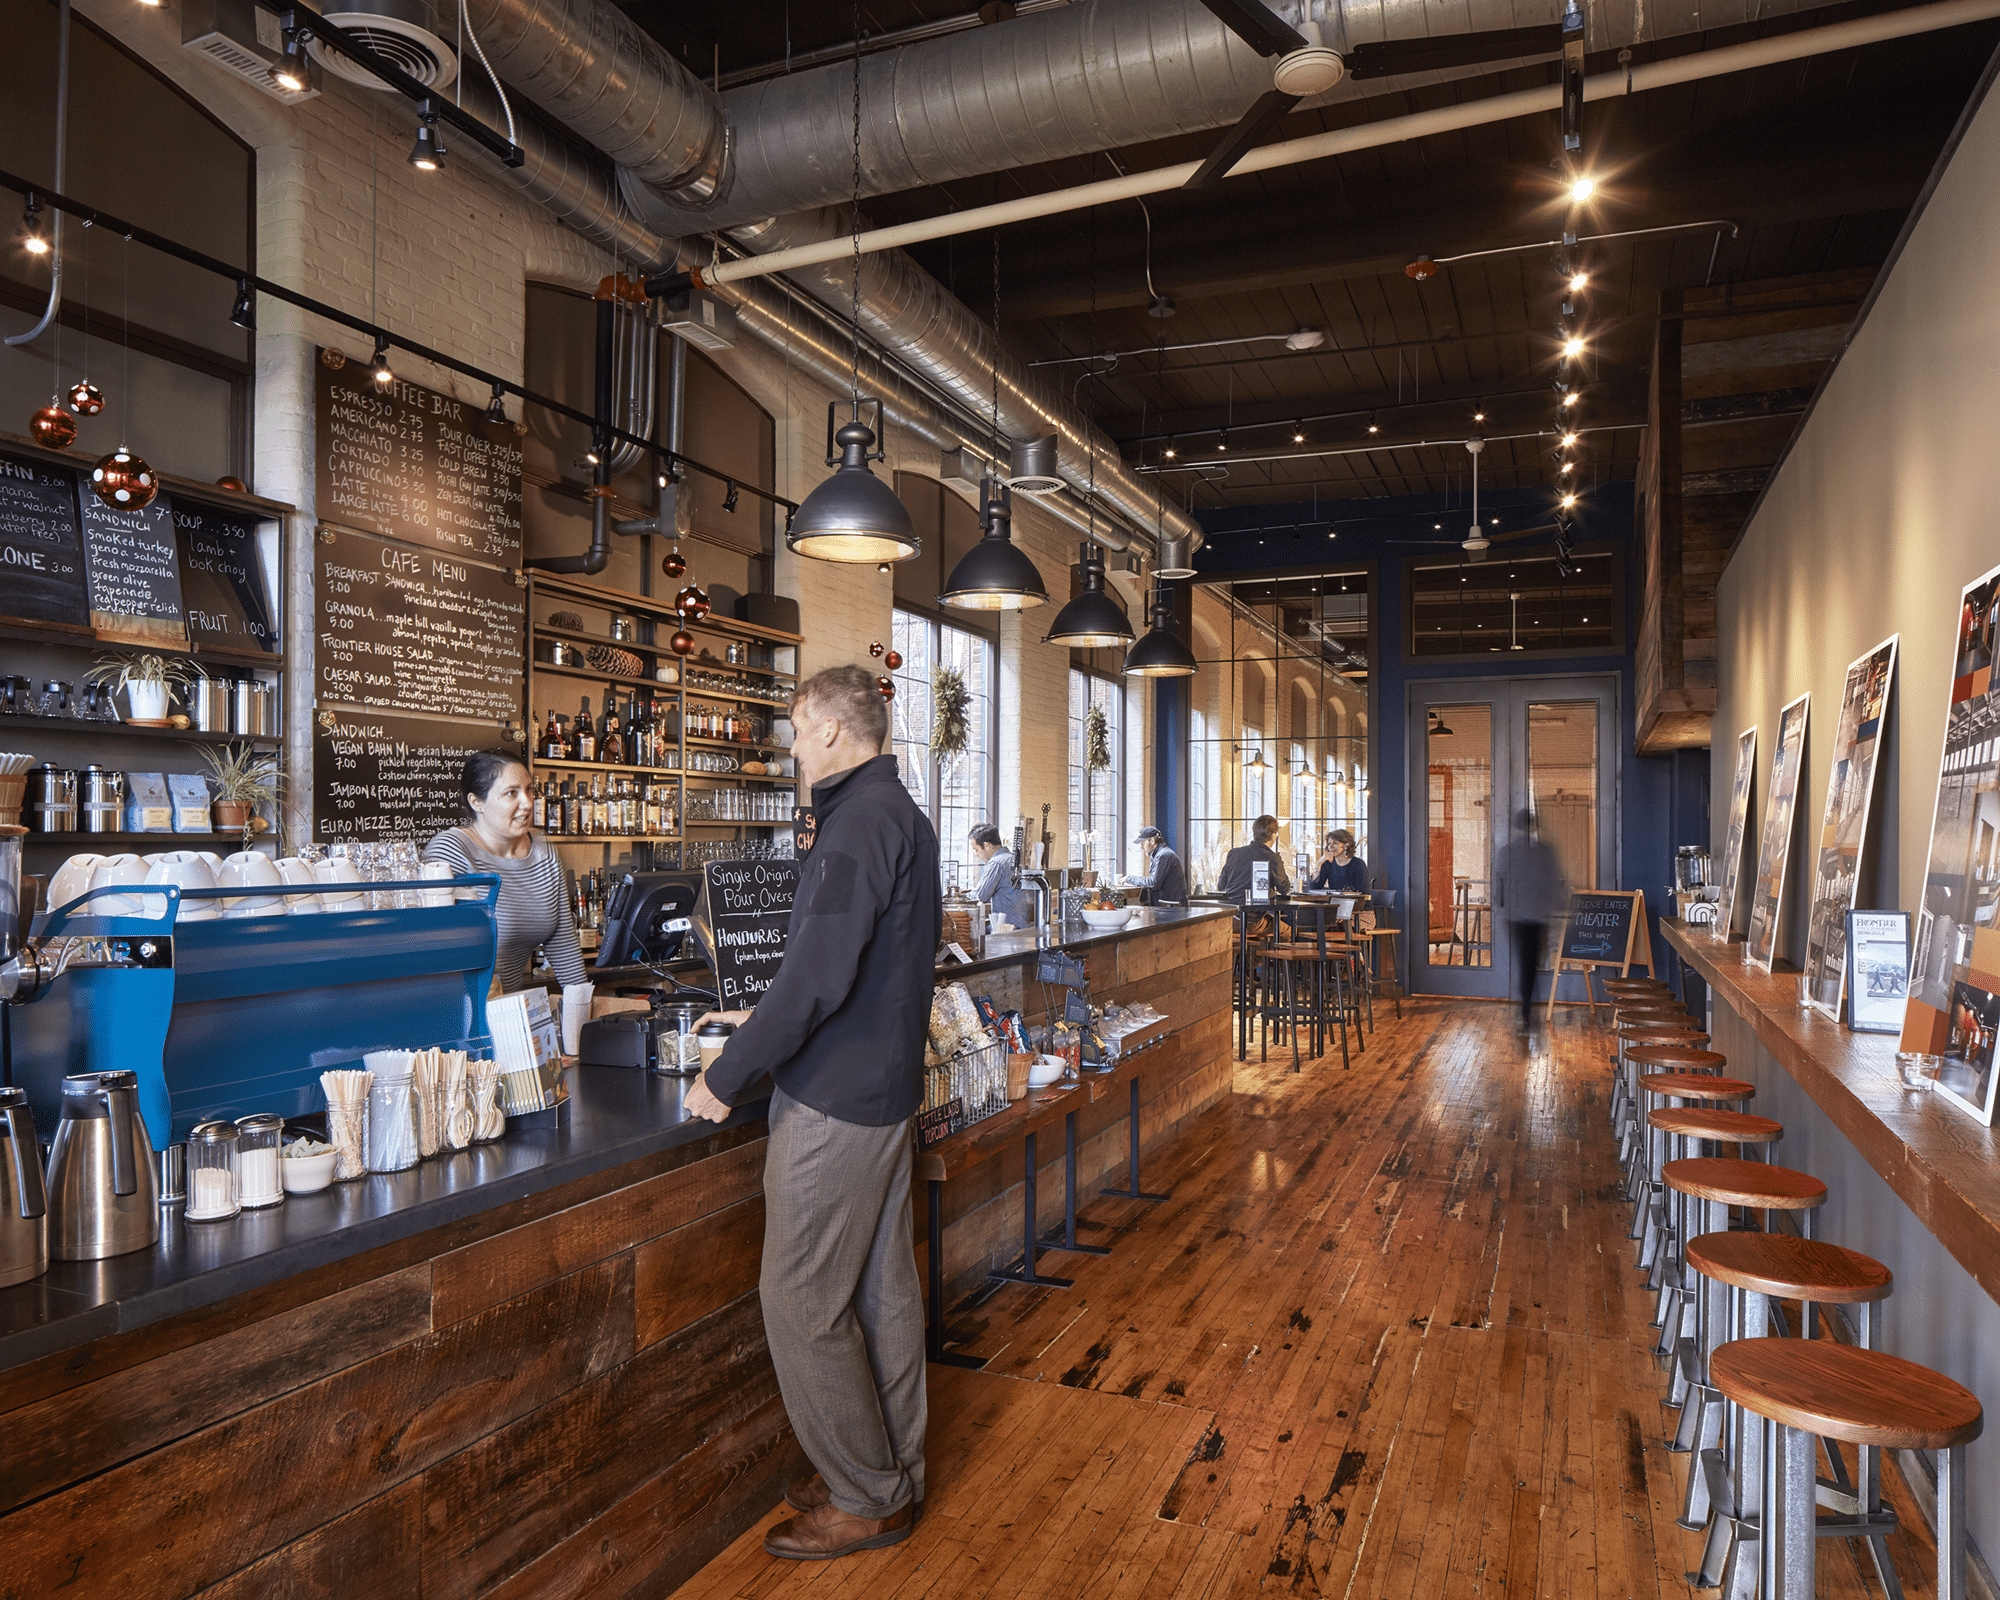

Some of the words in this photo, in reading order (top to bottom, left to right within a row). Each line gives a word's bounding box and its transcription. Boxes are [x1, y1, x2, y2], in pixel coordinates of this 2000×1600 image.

[331, 386, 392, 416] ESPRESSO
[400, 411, 423, 429] 2.75
[374, 379, 425, 408] COFFEE
[431, 396, 462, 422] BAR
[331, 404, 396, 435] AMERICANO
[400, 428, 423, 442] 2.75
[331, 423, 391, 453] MACCHIATO
[401, 446, 423, 461] 3.25
[439, 423, 462, 445] POUR
[466, 435, 491, 455] OVER
[333, 440, 389, 466] CORTADO
[401, 463, 423, 477] 3.50
[436, 440, 462, 457] FAST
[463, 449, 487, 466] COFFEE
[329, 455, 400, 487] CAPPUCCINO
[402, 478, 425, 493] 3.50
[439, 456, 460, 472] COLD
[463, 464, 487, 479] BREW
[41, 475, 65, 486] 3.00
[436, 471, 456, 486] RISHI
[473, 483, 490, 496] LATTE
[332, 473, 368, 494] LATTE
[372, 489, 380, 497] 12
[401, 494, 428, 512] 4.00
[437, 489, 451, 502] ZEN
[453, 491, 472, 505] BEAR
[485, 503, 504, 515] LATTE
[22, 501, 66, 516] walnut
[332, 491, 368, 509] LARGE
[371, 502, 398, 516] LATTE
[51, 520, 72, 532] 2.00
[85, 508, 151, 532] SANDWICH
[173, 510, 202, 530] SOUP
[437, 508, 452, 523] HOT
[455, 513, 499, 535] CHOCOLATE
[31, 524, 61, 543] free)
[436, 527, 456, 544] RISHI
[87, 529, 135, 547] Smoked
[137, 538, 173, 560] turkey
[91, 543, 128, 557] genoa
[134, 552, 169, 565] salami
[189, 533, 225, 557] lamb
[51, 562, 73, 573] 3.00
[92, 557, 120, 569] fresh
[121, 562, 174, 579] mozzarella
[217, 561, 246, 584] choy
[324, 562, 380, 584] BREAKFAST
[382, 548, 421, 573] CAFE
[432, 559, 466, 582] MENU
[92, 571, 120, 583] green
[123, 574, 150, 589] olive
[327, 580, 350, 593] 7.00
[95, 604, 147, 616] arugula
[113, 596, 148, 609] pepper
[150, 600, 178, 614] relish
[329, 616, 353, 629] 5.00
[386, 614, 413, 629] maple
[415, 615, 428, 629] hill
[430, 621, 456, 633] vanilla
[459, 627, 482, 641] yogurt
[321, 633, 372, 654] FRONTIER
[374, 643, 403, 658] HOUSE
[323, 667, 362, 683] CAESAR
[394, 671, 411, 680] wine
[501, 674, 512, 684] red
[331, 740, 363, 755] VEGAN
[368, 742, 392, 755] BAHN
[396, 741, 409, 760] MI
[417, 747, 440, 757] asian
[441, 745, 463, 757] baked
[335, 757, 356, 770] 7.00
[378, 754, 405, 771] pickled
[378, 771, 405, 781] cashew
[329, 782, 369, 799] JAMBON
[378, 785, 422, 800] FROMAGE
[335, 800, 355, 809] 7.00
[321, 819, 352, 833] EURO
[355, 815, 391, 831] MEZZE
[394, 815, 415, 830] BOX
[421, 814, 458, 826] calabrese
[712, 864, 751, 892] Single
[754, 864, 794, 888] Origin
[724, 888, 755, 908] Pour
[759, 887, 793, 907] Overs
[1577, 900, 1602, 909] PLEASE
[1605, 900, 1629, 910] ENTER
[1575, 912, 1620, 927] THEATER
[1856, 919, 1897, 927] FRONTIER
[717, 928, 780, 947] HONDURAS
[723, 977, 742, 998] EL
[920, 1108, 942, 1129] LITTLE
[925, 1121, 949, 1144] POPCORN
